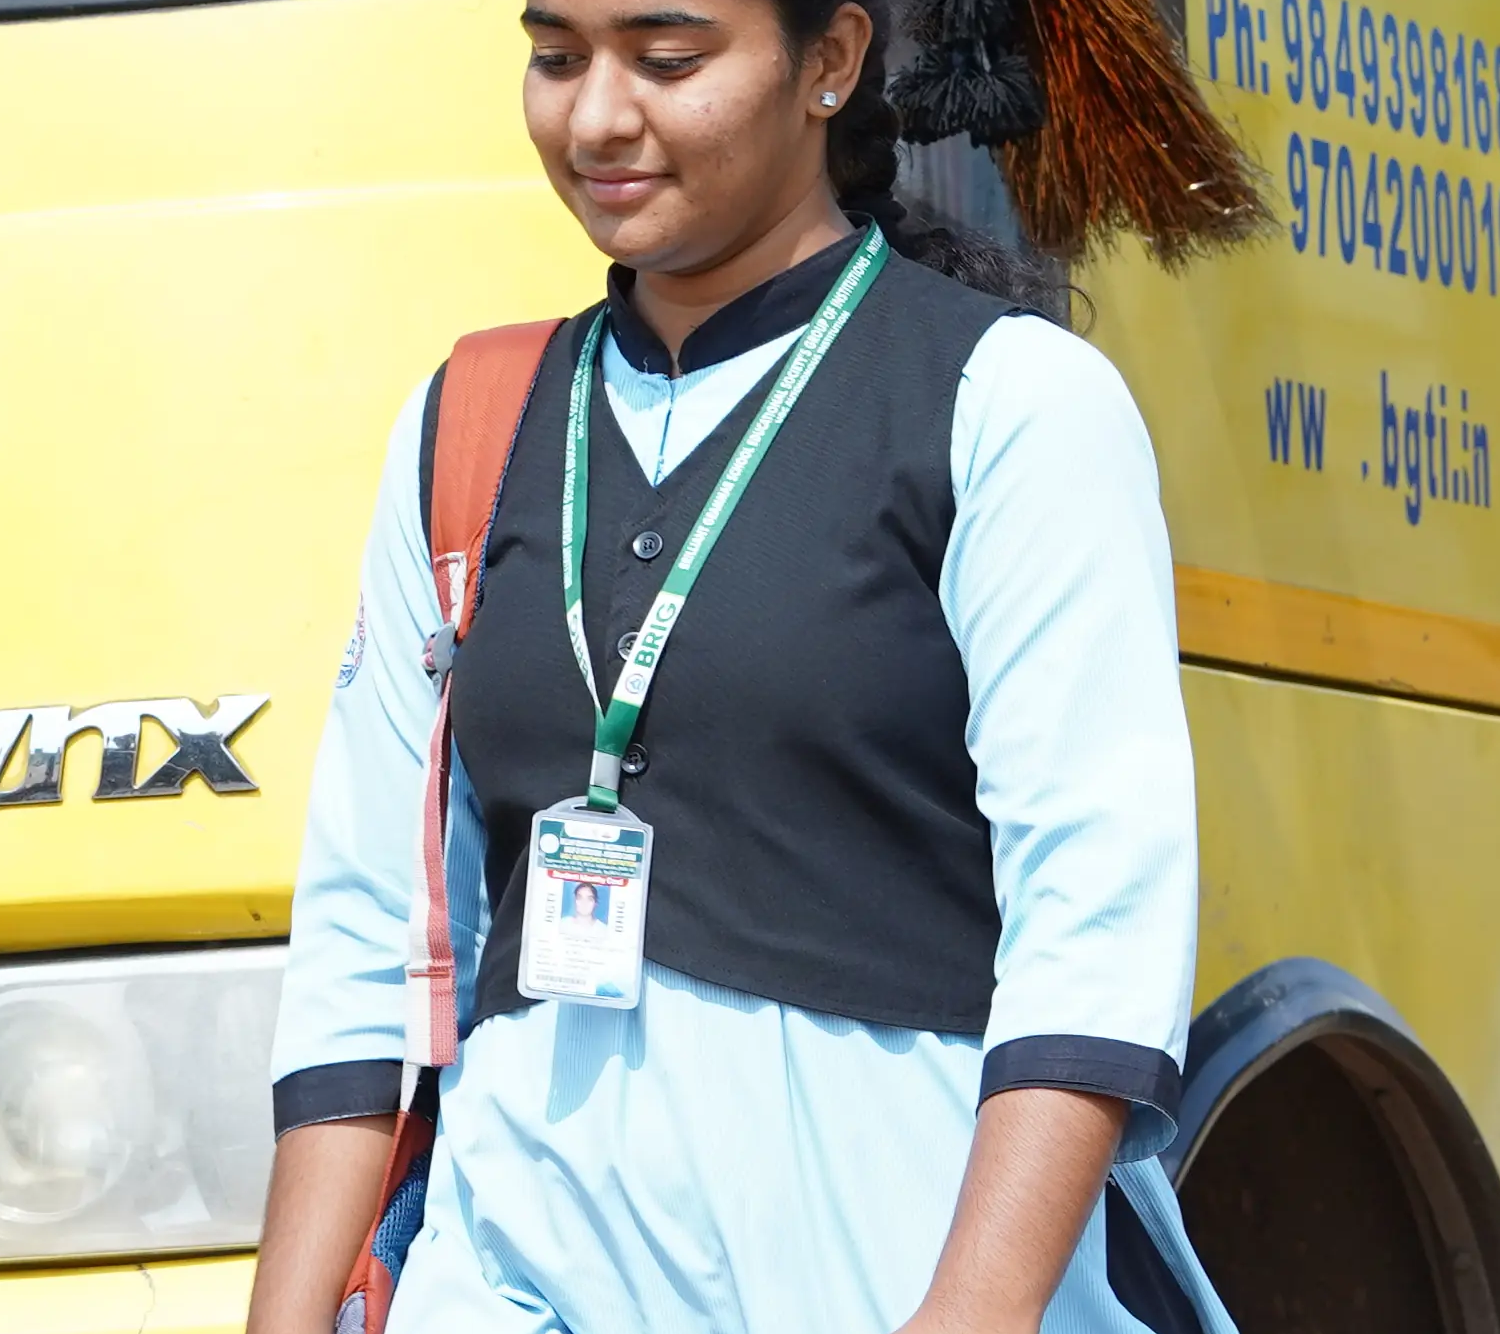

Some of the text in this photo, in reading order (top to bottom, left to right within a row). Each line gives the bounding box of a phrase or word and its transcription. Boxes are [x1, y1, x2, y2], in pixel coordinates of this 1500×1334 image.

[677, 525, 710, 571] BRILLIANT
[702, 480, 735, 526] GRAMMAR
[726, 447, 756, 482] SCHOOL
[746, 389, 789, 447] EDUCATIONAL
[803, 318, 829, 349] GROUP
[822, 305, 838, 320] OF
[830, 255, 871, 309] INSTITUTIONS
[634, 603, 676, 668] BRIG
